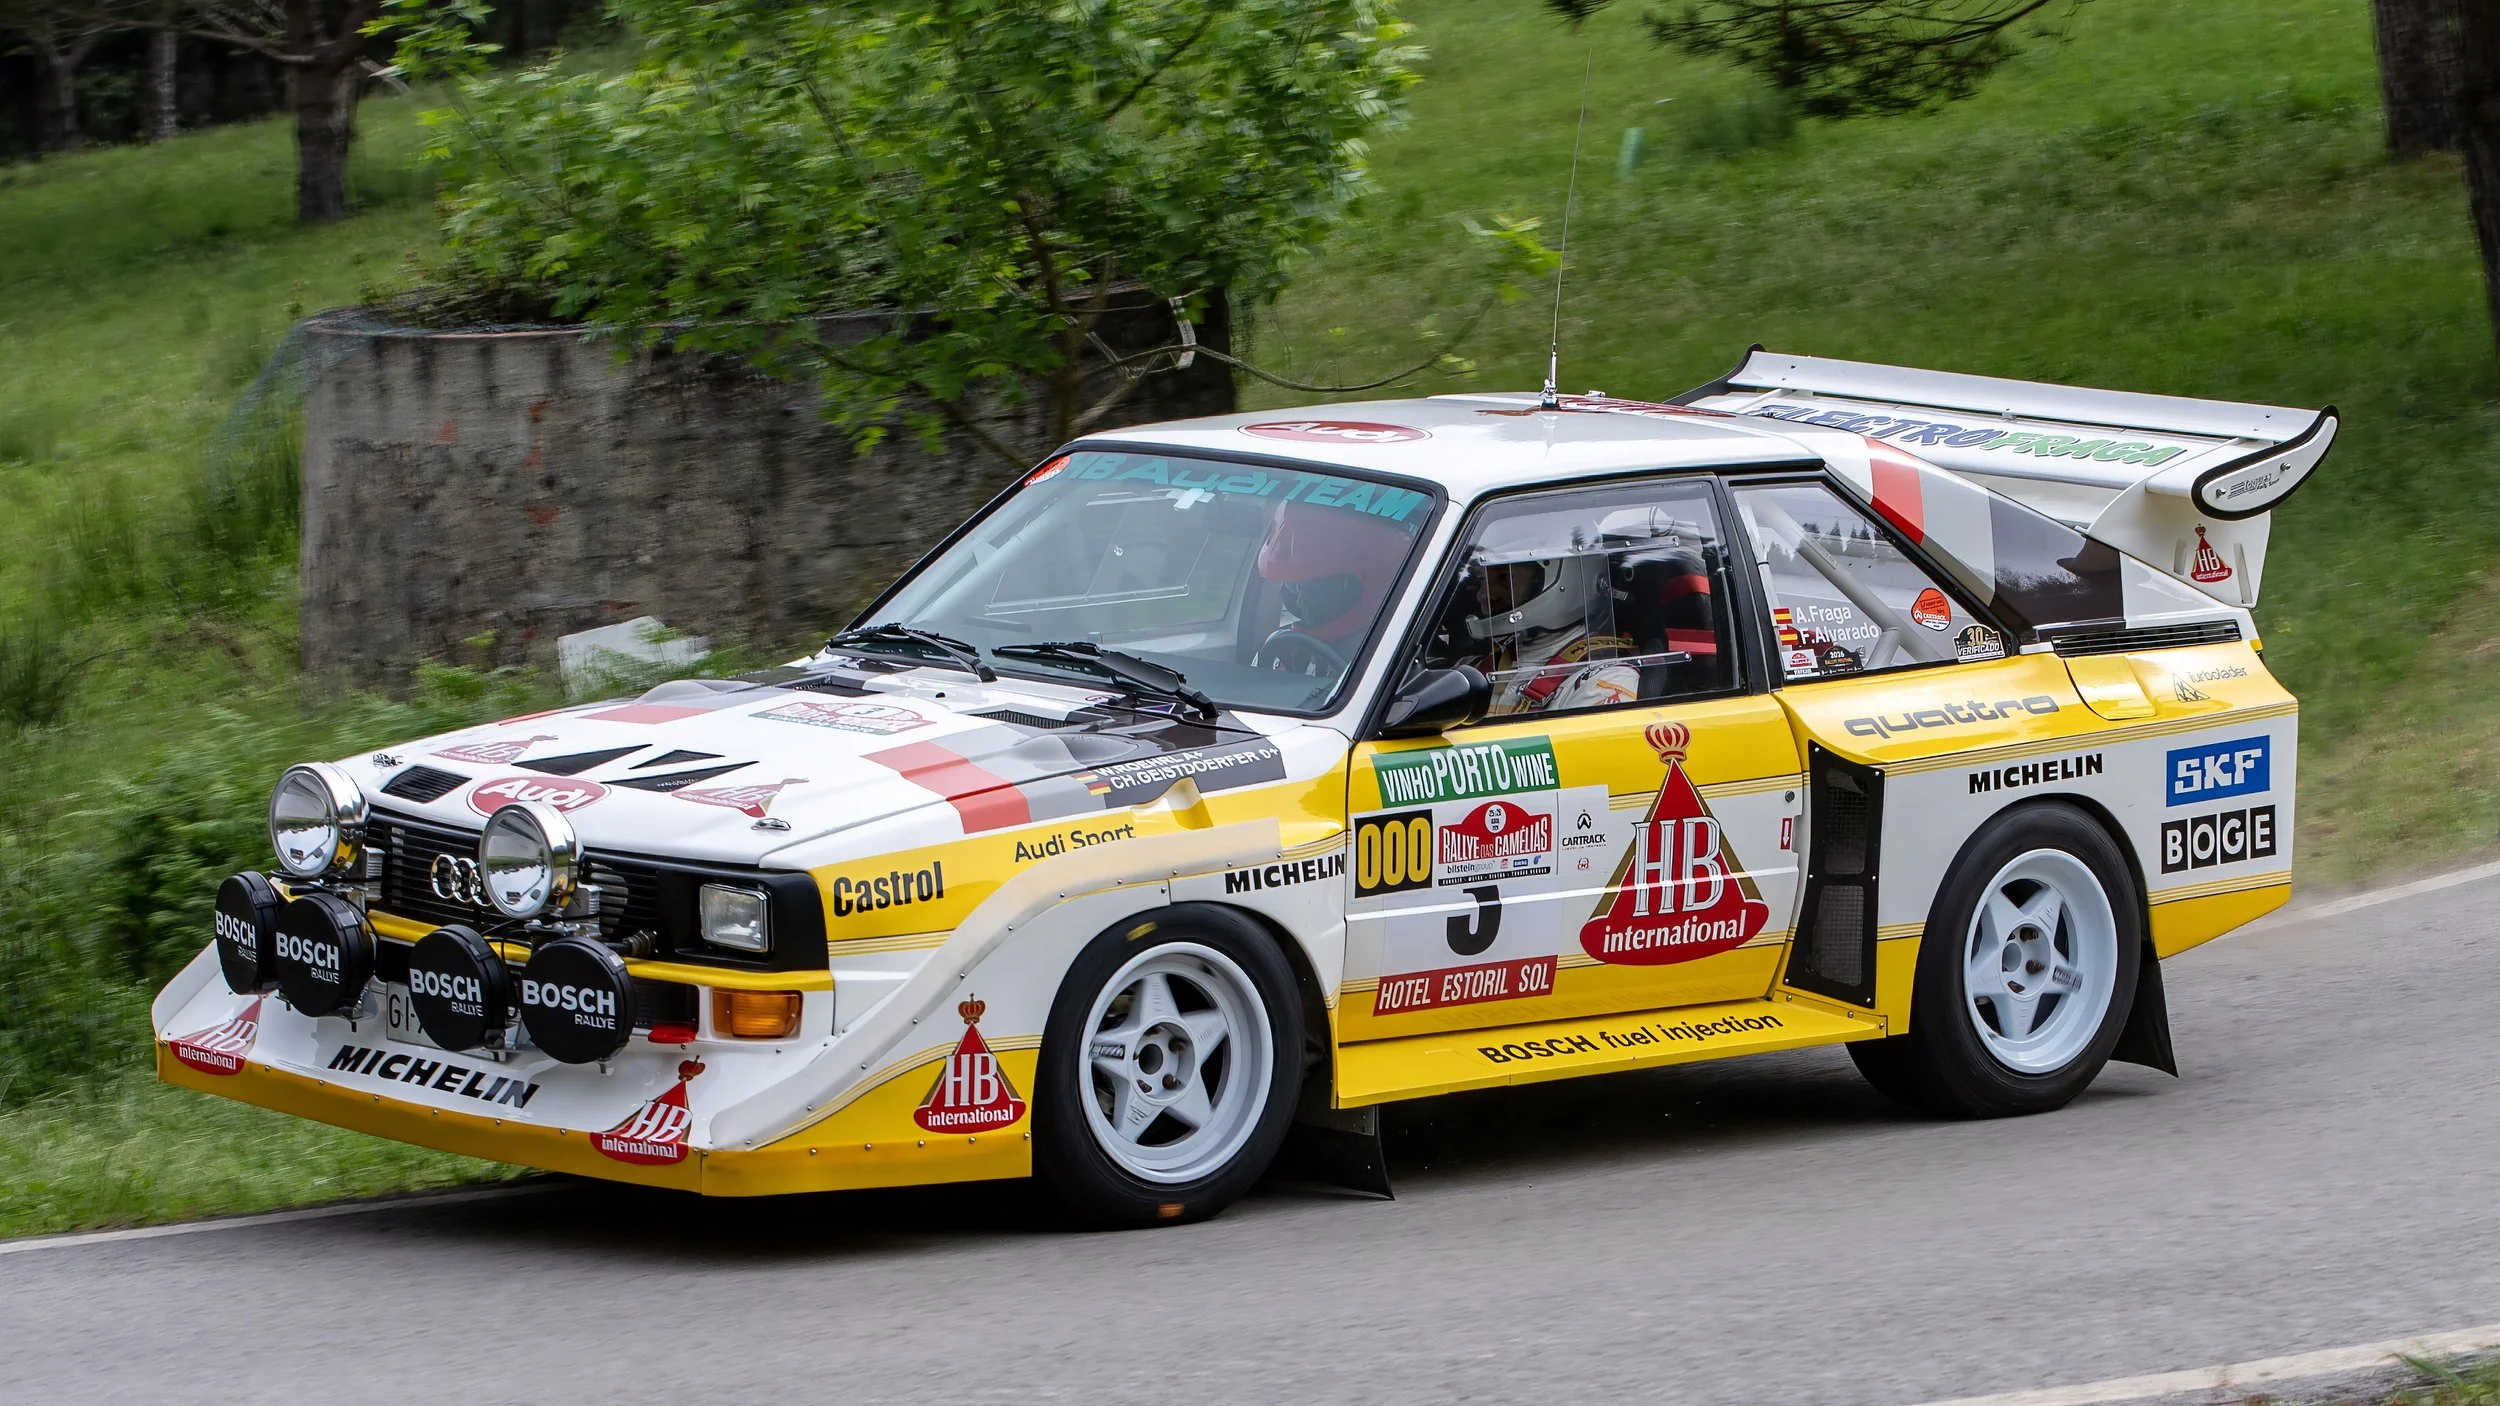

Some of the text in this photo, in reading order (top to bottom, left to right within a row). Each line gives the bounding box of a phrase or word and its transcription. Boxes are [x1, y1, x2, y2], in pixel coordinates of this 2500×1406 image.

[1285, 471, 1425, 521] TEAM
[2197, 548, 2221, 571] HB
[1795, 605, 1852, 624] A.Fraga
[1799, 622, 1882, 645] F.Alvarado
[1957, 642, 2000, 656] VERIFICADO
[1966, 626, 1984, 647] 30
[1844, 694, 2060, 740] quattro
[1110, 749, 1261, 790] CH.GEISTDOERFER
[1381, 744, 1556, 803] VINHO PORTO WINE
[1968, 753, 2103, 795] MICHELIN
[2174, 748, 2261, 795] SKF
[477, 779, 595, 809] Audi
[1014, 833, 1067, 863] Audi
[1357, 815, 1431, 891] 000
[1442, 825, 1480, 864] RALLYE
[1494, 816, 1548, 856] CAMÉLIAS
[1561, 833, 1606, 847] CARTRACK
[2165, 813, 2272, 867] BOGE
[1224, 852, 1345, 895] MICHELIN
[1633, 815, 1723, 917] HB
[832, 861, 945, 918] Castrol
[214, 909, 257, 950] BOSCH
[1602, 909, 1747, 954] international
[275, 931, 340, 971] BOSCH
[311, 967, 340, 985] RALLYE
[409, 968, 483, 1003] BOSCH
[1380, 977, 1431, 1011] HOTEL
[1440, 967, 1509, 1002] ESTORIL
[1518, 962, 1550, 994] SOL
[451, 1001, 484, 1017] RALLYE
[521, 979, 616, 1017] BOSCH
[192, 1018, 259, 1052] HB
[574, 1013, 616, 1030] RALLYE
[1478, 1012, 1784, 1064] BOSCH fuel injection
[179, 1042, 237, 1071] international
[327, 1044, 543, 1110] MICHELIN
[944, 1053, 1001, 1107] HB
[619, 1100, 694, 1143] HB
[926, 1104, 1014, 1127] international
[601, 1134, 679, 1159] international
